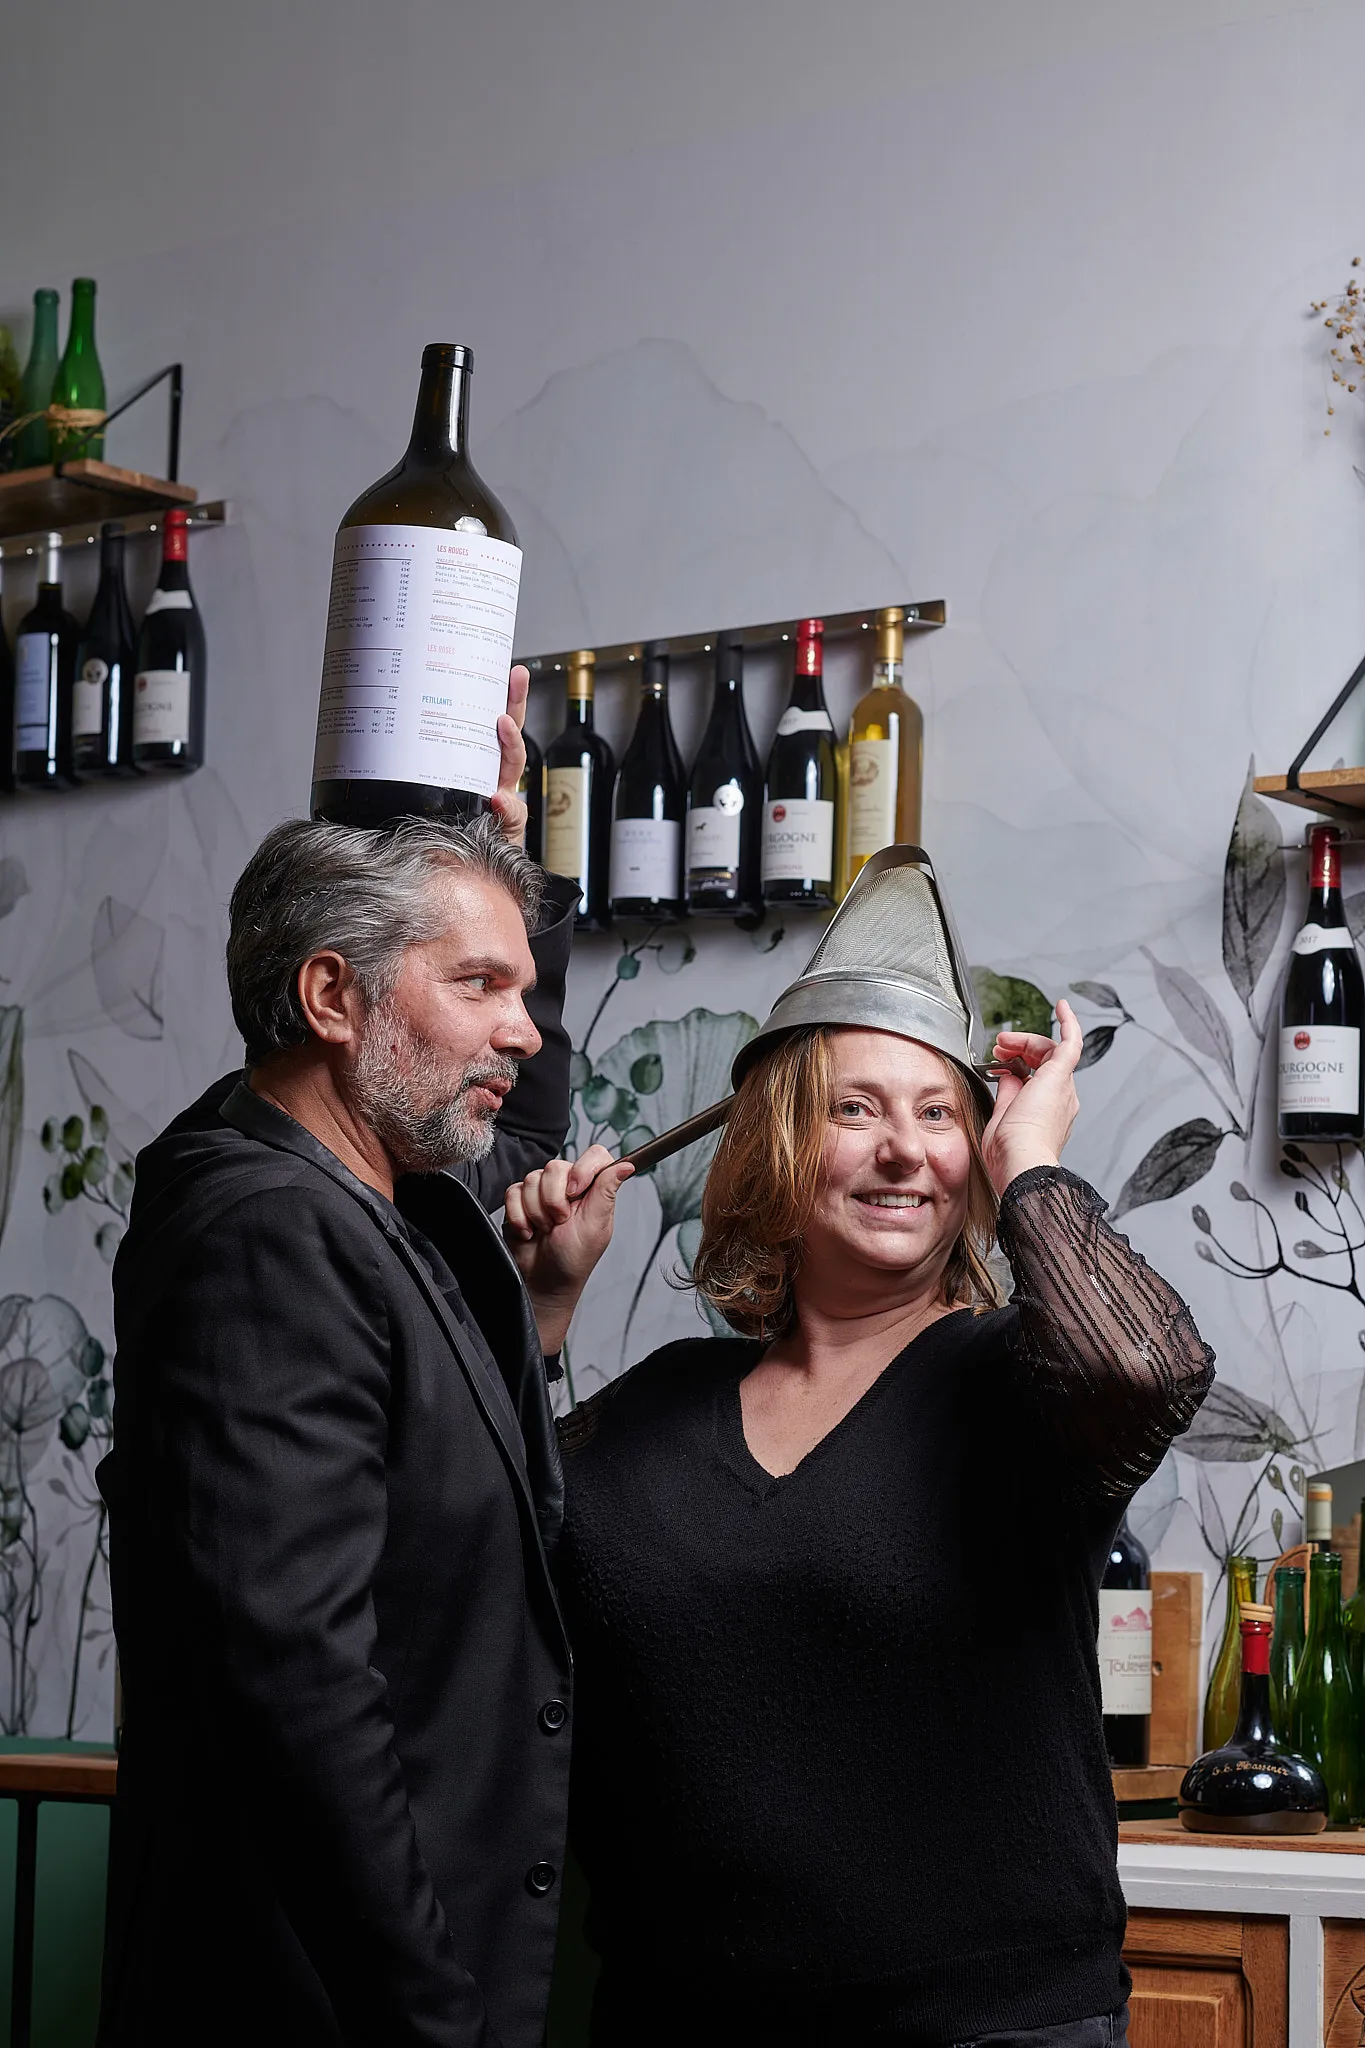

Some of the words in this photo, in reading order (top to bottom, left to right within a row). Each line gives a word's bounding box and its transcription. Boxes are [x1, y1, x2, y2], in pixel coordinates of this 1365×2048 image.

[437, 544, 447, 552] LES
[448, 546, 469, 556] ROUGES
[427, 644, 437, 652] LES
[421, 695, 453, 707] PETILLANTS
